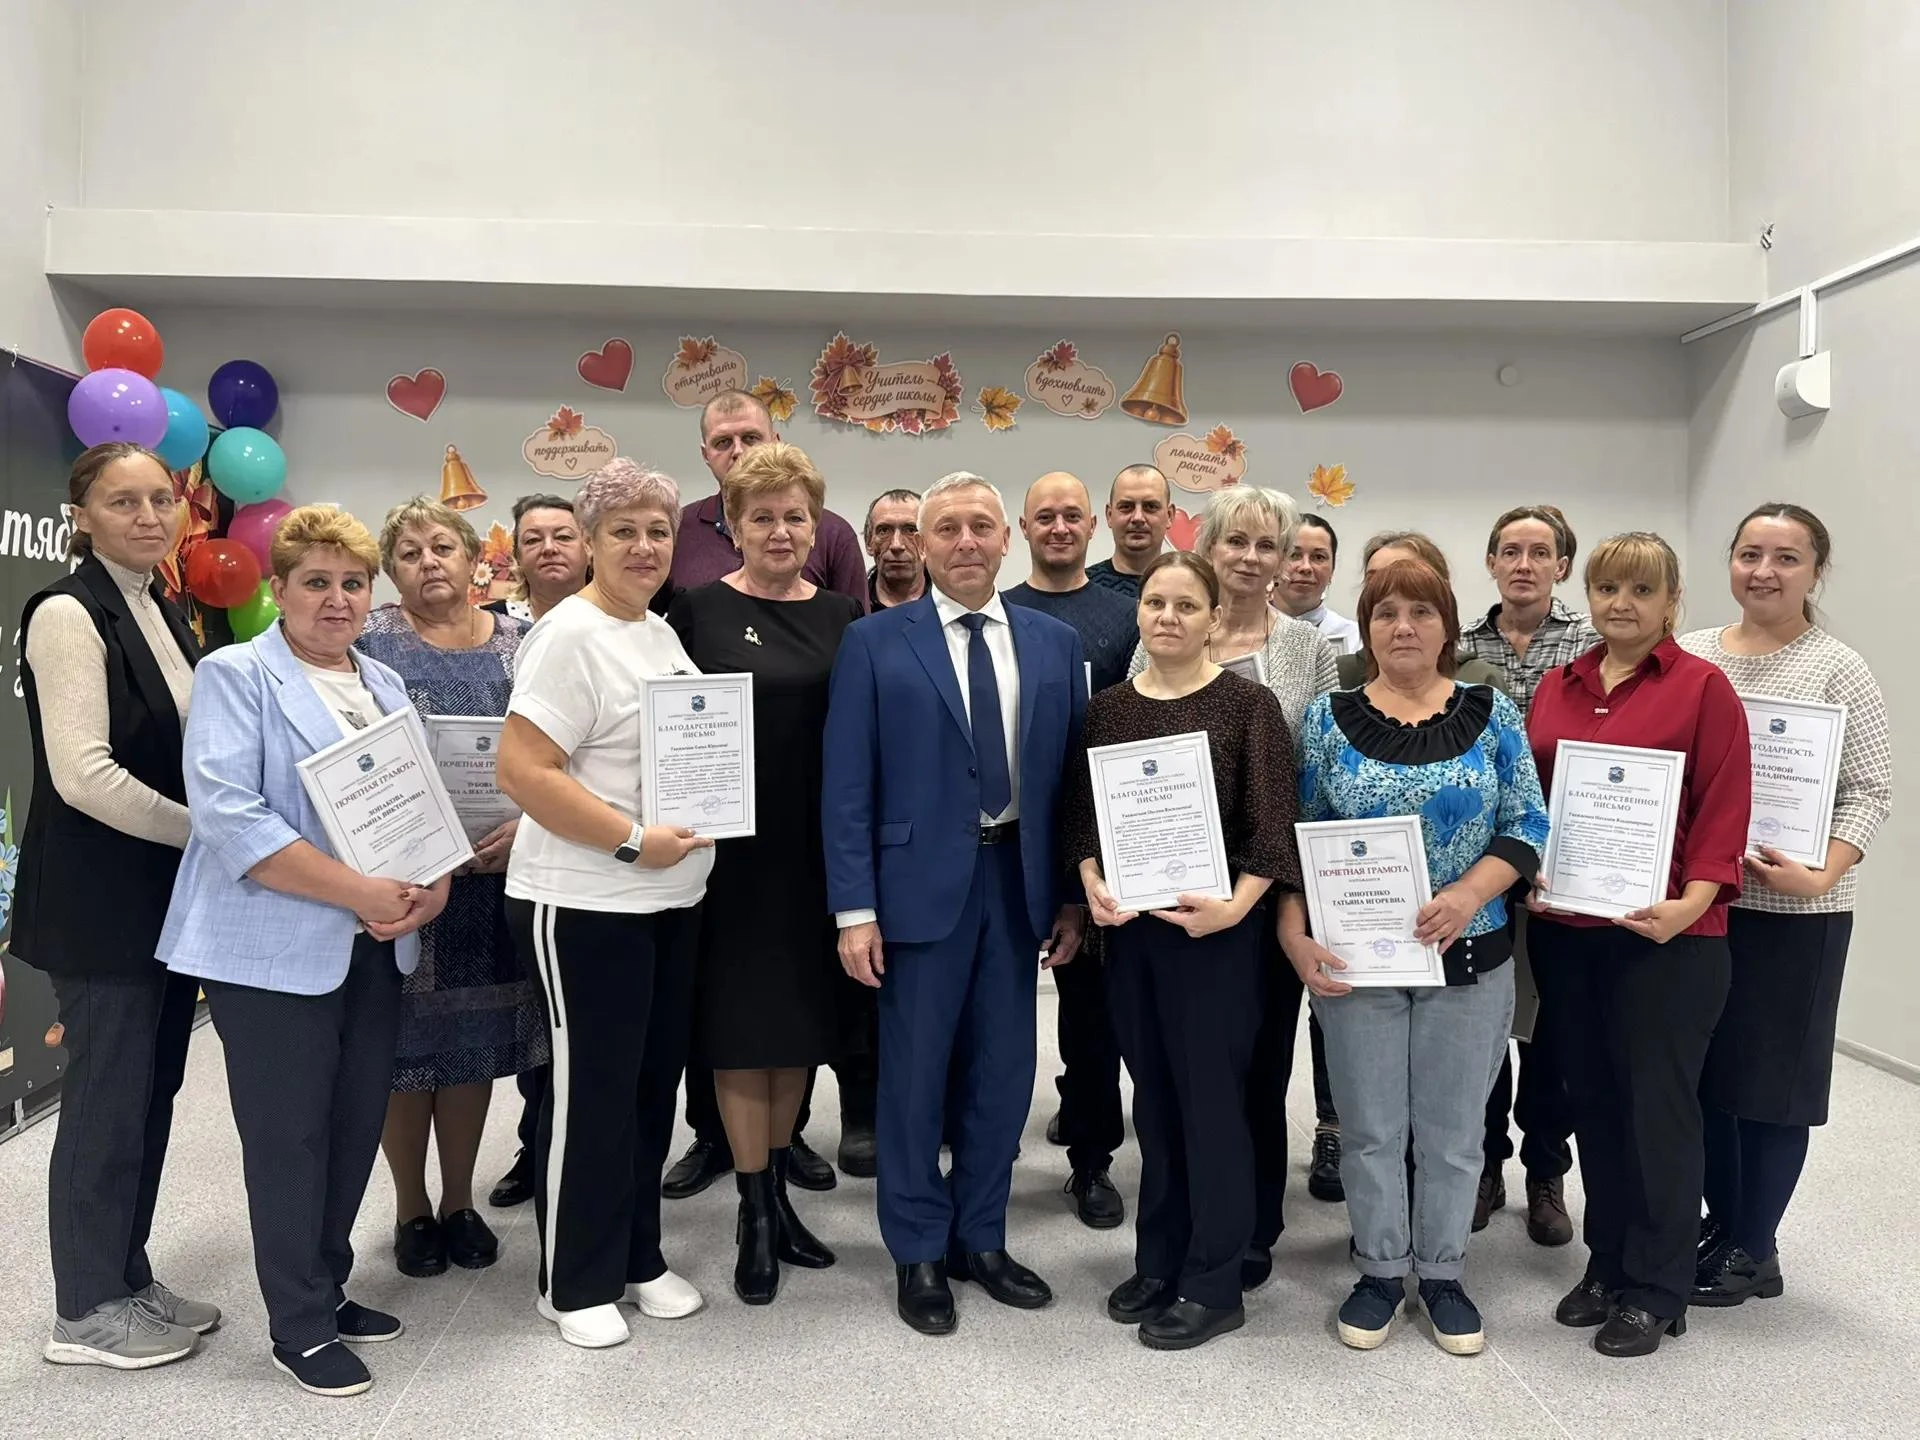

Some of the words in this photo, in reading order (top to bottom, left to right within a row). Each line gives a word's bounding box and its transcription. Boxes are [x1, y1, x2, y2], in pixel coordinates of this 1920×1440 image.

[675, 362, 737, 391] открывать
[865, 371, 924, 393] Учитель
[1035, 371, 1106, 397] вдохновлять
[699, 378, 721, 394] мир
[853, 393, 893, 411] сердце
[895, 390, 937, 404] школы
[534, 440, 609, 460] поддерживать
[1169, 448, 1227, 466] помогать
[1176, 461, 1218, 475] расти
[658, 720, 738, 732] БЛАГОДАРСТВЕННОЕ
[682, 730, 716, 739] ПИСЬМО
[1750, 743, 1815, 757] АГОДАРНОСТЬ
[1110, 781, 1197, 800] БЛАГОДАРСТВЕННОЕ
[1136, 793, 1173, 804] ПИСЬМО
[1568, 790, 1660, 807] БЛАГОДАРСТВЕННОЕ
[1593, 801, 1632, 811] ПИСЬМО
[1319, 867, 1365, 877] ПОЧЕТНАЯ
[1367, 865, 1410, 875] ГРАМОТА
